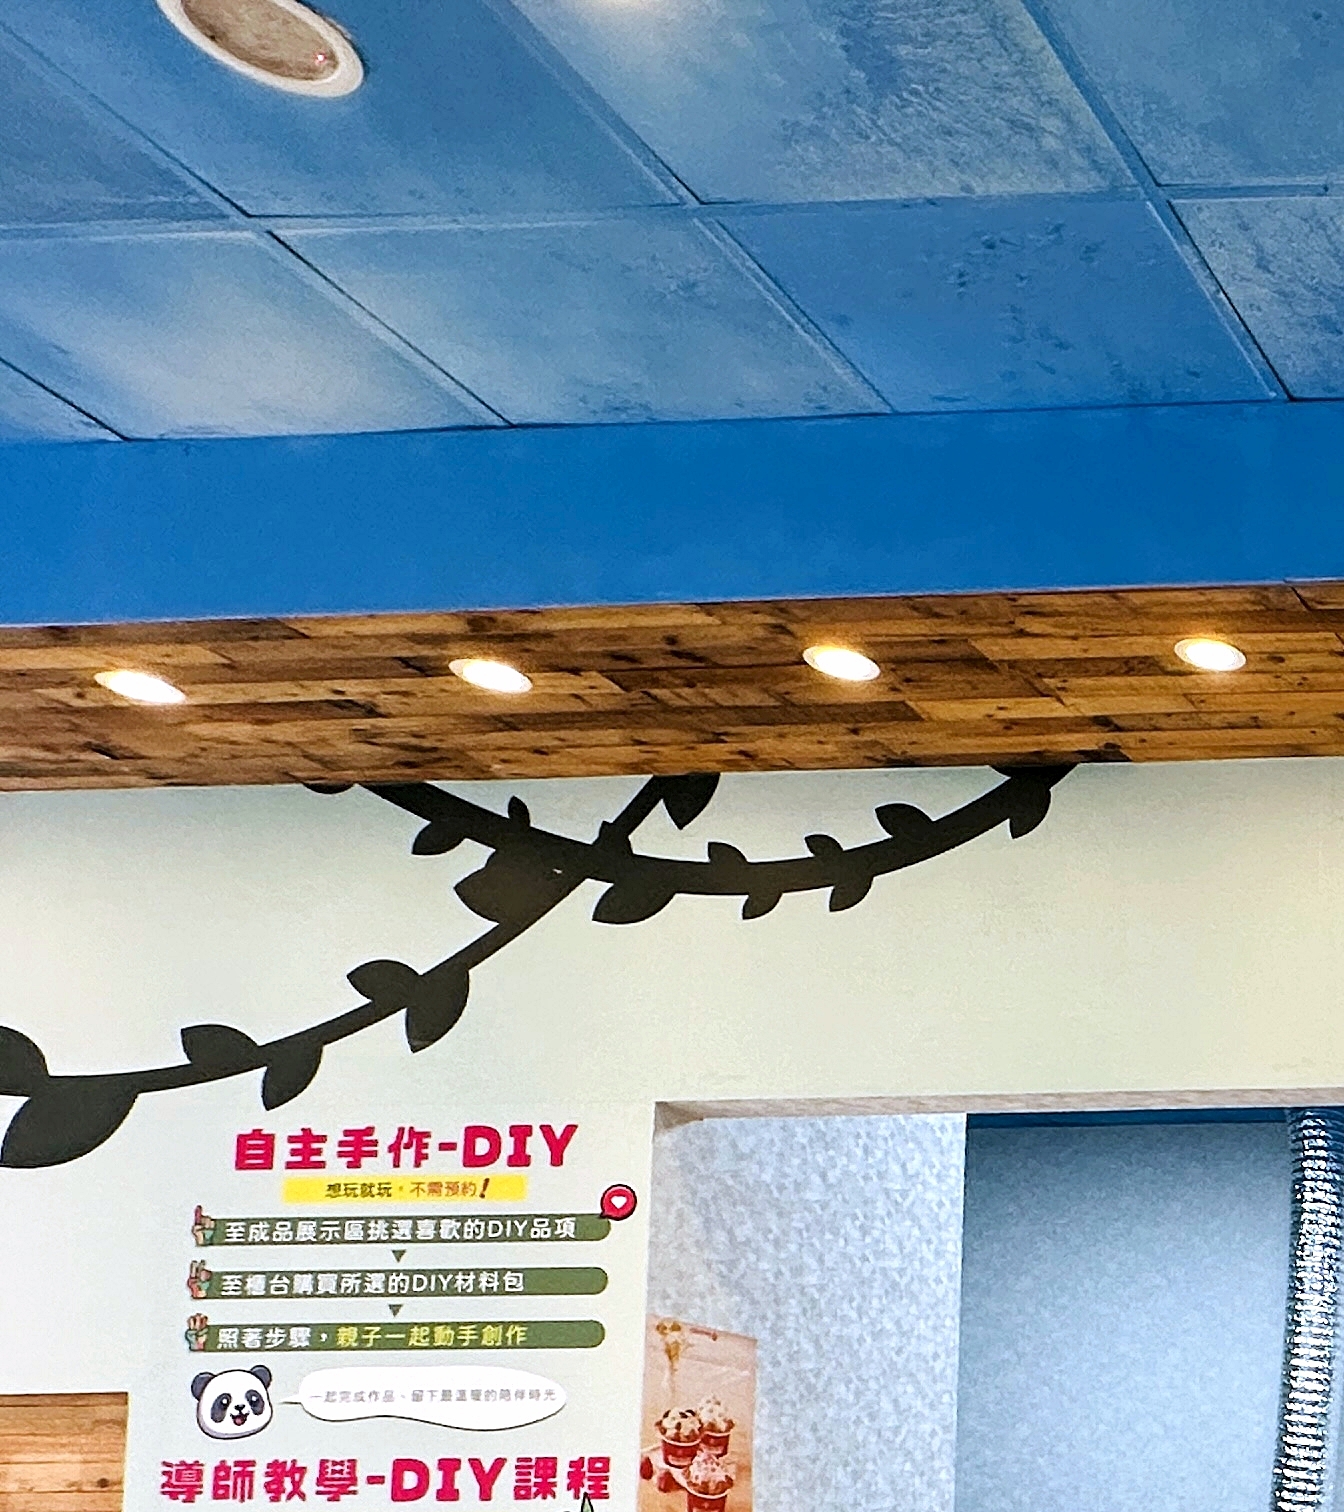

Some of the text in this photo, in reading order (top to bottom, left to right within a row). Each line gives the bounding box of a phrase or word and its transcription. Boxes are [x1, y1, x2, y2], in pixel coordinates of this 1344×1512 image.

[234, 1123, 580, 1171] 自主手作-DIY
[224, 1216, 577, 1244] 至成品展示區挑選喜歡的DIY品項
[220, 1271, 525, 1296] 至櫃台購買所選的DIY材料包
[159, 1456, 612, 1503] 導師教學-DIY課程
